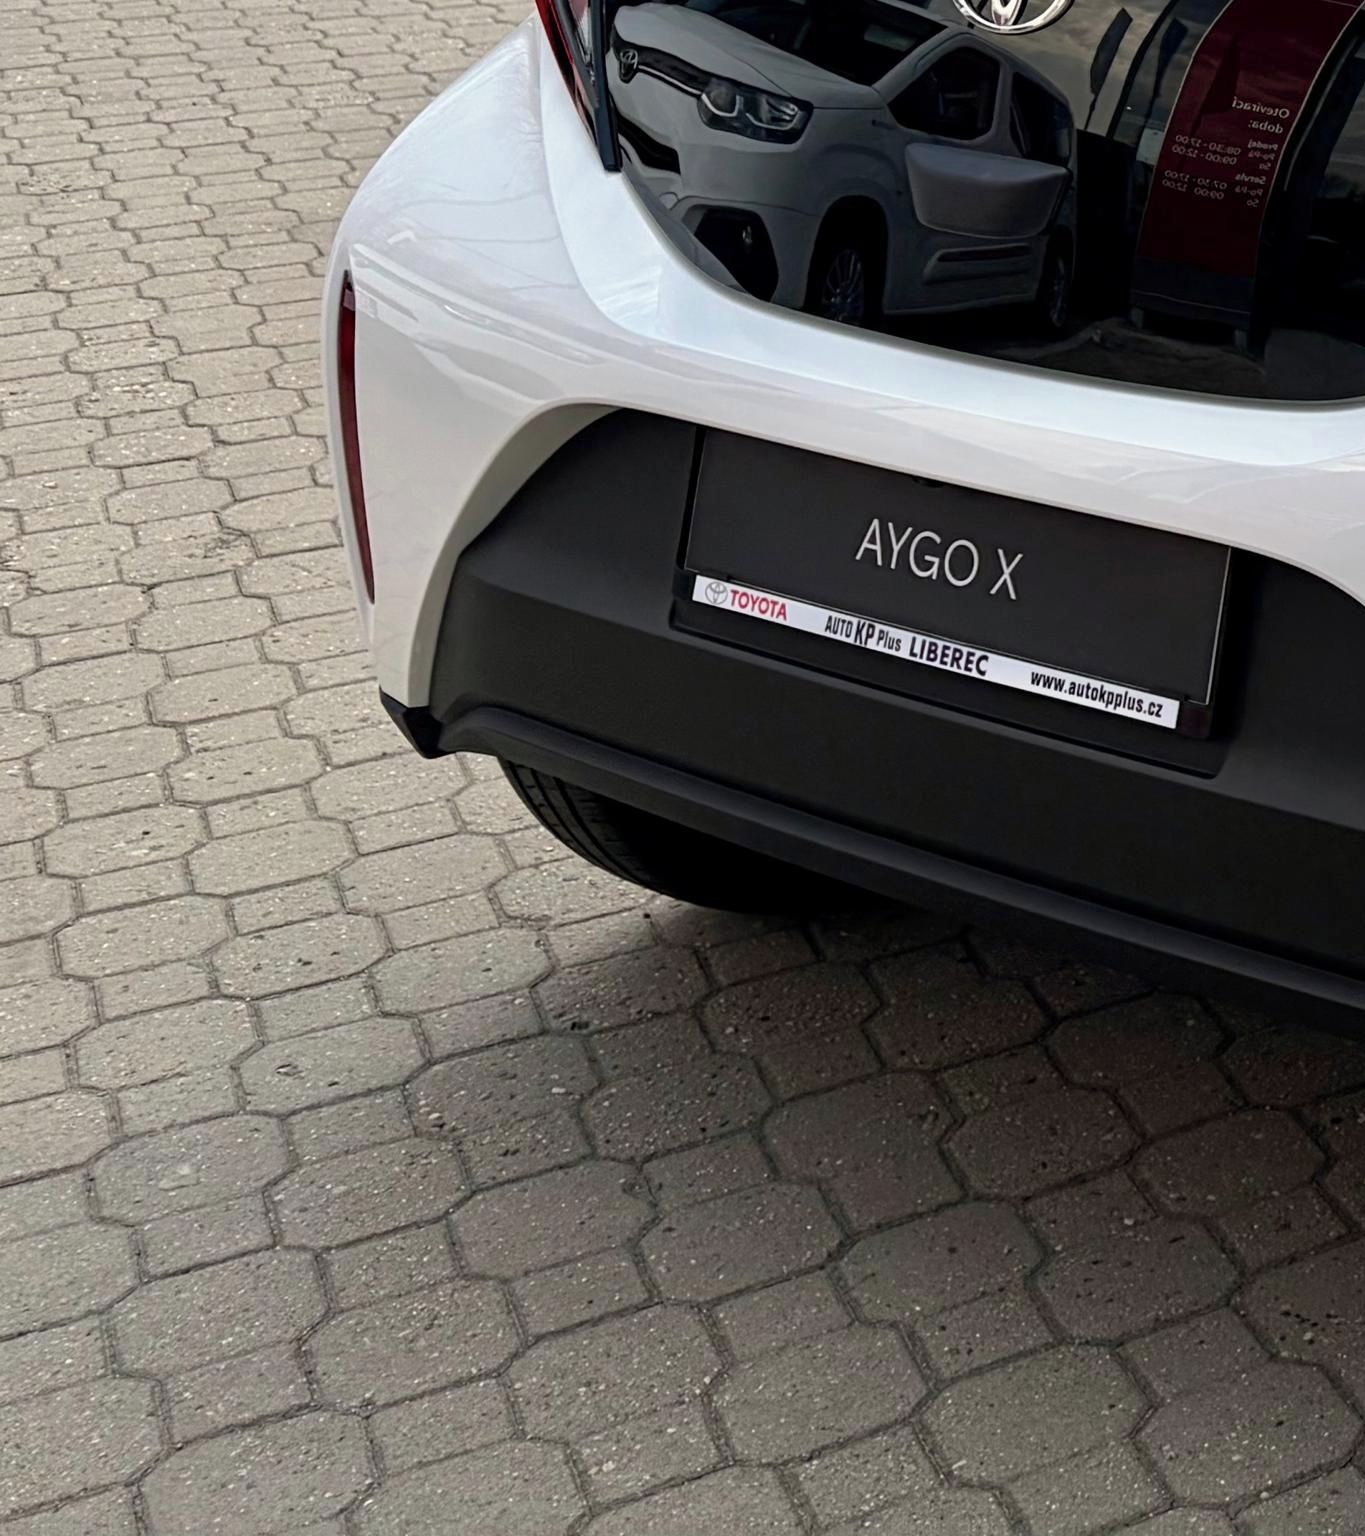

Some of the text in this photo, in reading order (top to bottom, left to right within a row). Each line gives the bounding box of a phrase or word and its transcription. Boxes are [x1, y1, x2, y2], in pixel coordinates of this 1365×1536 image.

[855, 518, 1025, 601] AYGO X
[730, 589, 788, 621] TOYOTA
[825, 615, 990, 677] AUTO KP Plus LIBEREC
[1030, 670, 1164, 719] www.autokpplus.cz
